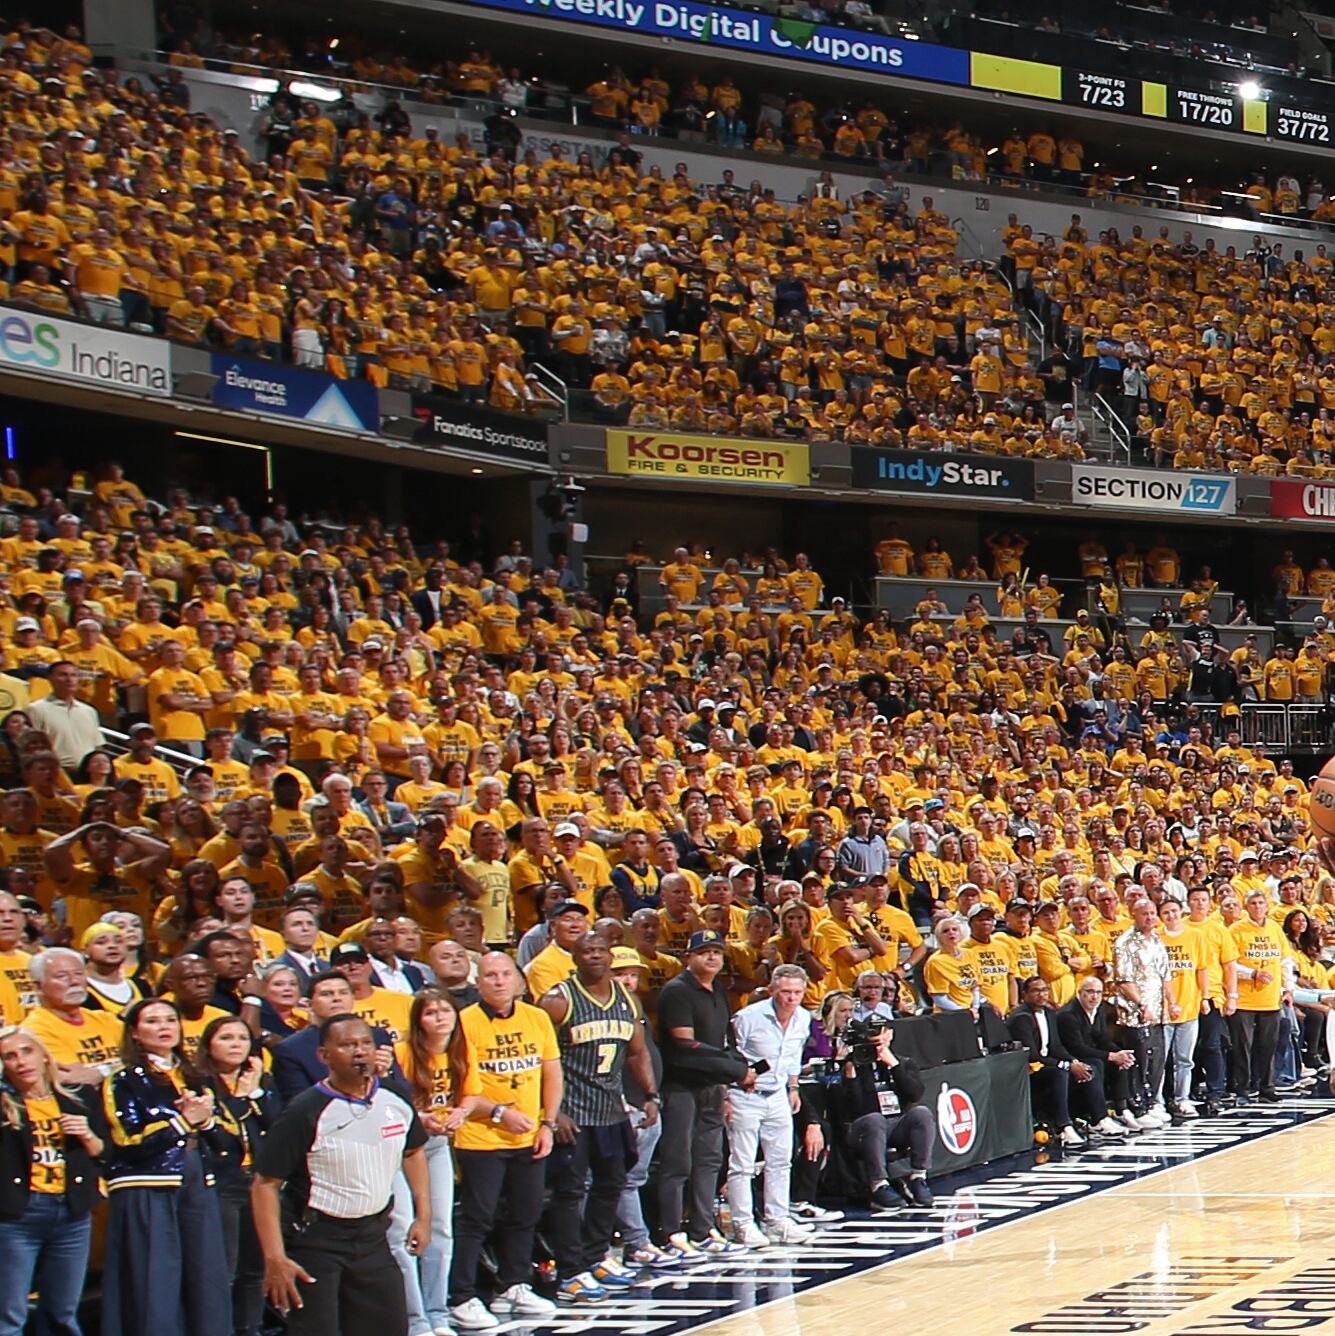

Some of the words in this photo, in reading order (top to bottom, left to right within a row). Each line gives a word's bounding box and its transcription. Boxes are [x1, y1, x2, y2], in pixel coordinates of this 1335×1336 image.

[522, 0, 645, 26] eekly
[655, 4, 760, 42] Digital
[770, 28, 904, 68] Cupons
[1078, 73, 1112, 87] 3-POINT
[1113, 79, 1126, 89] FG
[1080, 84, 1126, 107] 7/23
[1177, 90, 1198, 101] FREE
[1199, 93, 1233, 107] THROWS
[1179, 101, 1233, 125] 17/20
[1279, 108, 1300, 118] FIELD
[1301, 111, 1328, 123] GOALS
[1277, 118, 1330, 142] 37/72
[71, 342, 168, 391] Indiana
[225, 370, 287, 396] Elevance
[255, 393, 287, 407] Health
[433, 415, 484, 441] Fanatics
[484, 427, 549, 453] Sportsbook
[628, 436, 785, 468] Koorsen
[628, 460, 665, 472] FIRE
[675, 464, 689, 473] &
[698, 466, 785, 480] SECURITY
[1077, 476, 1183, 500] SECTION
[1186, 484, 1222, 504] 127
[495, 1032, 522, 1044] BUT
[486, 1046, 521, 1058] THIS
[524, 1044, 538, 1056] IS
[596, 1043, 617, 1074] 7
[478, 1056, 542, 1073] INDIANA
